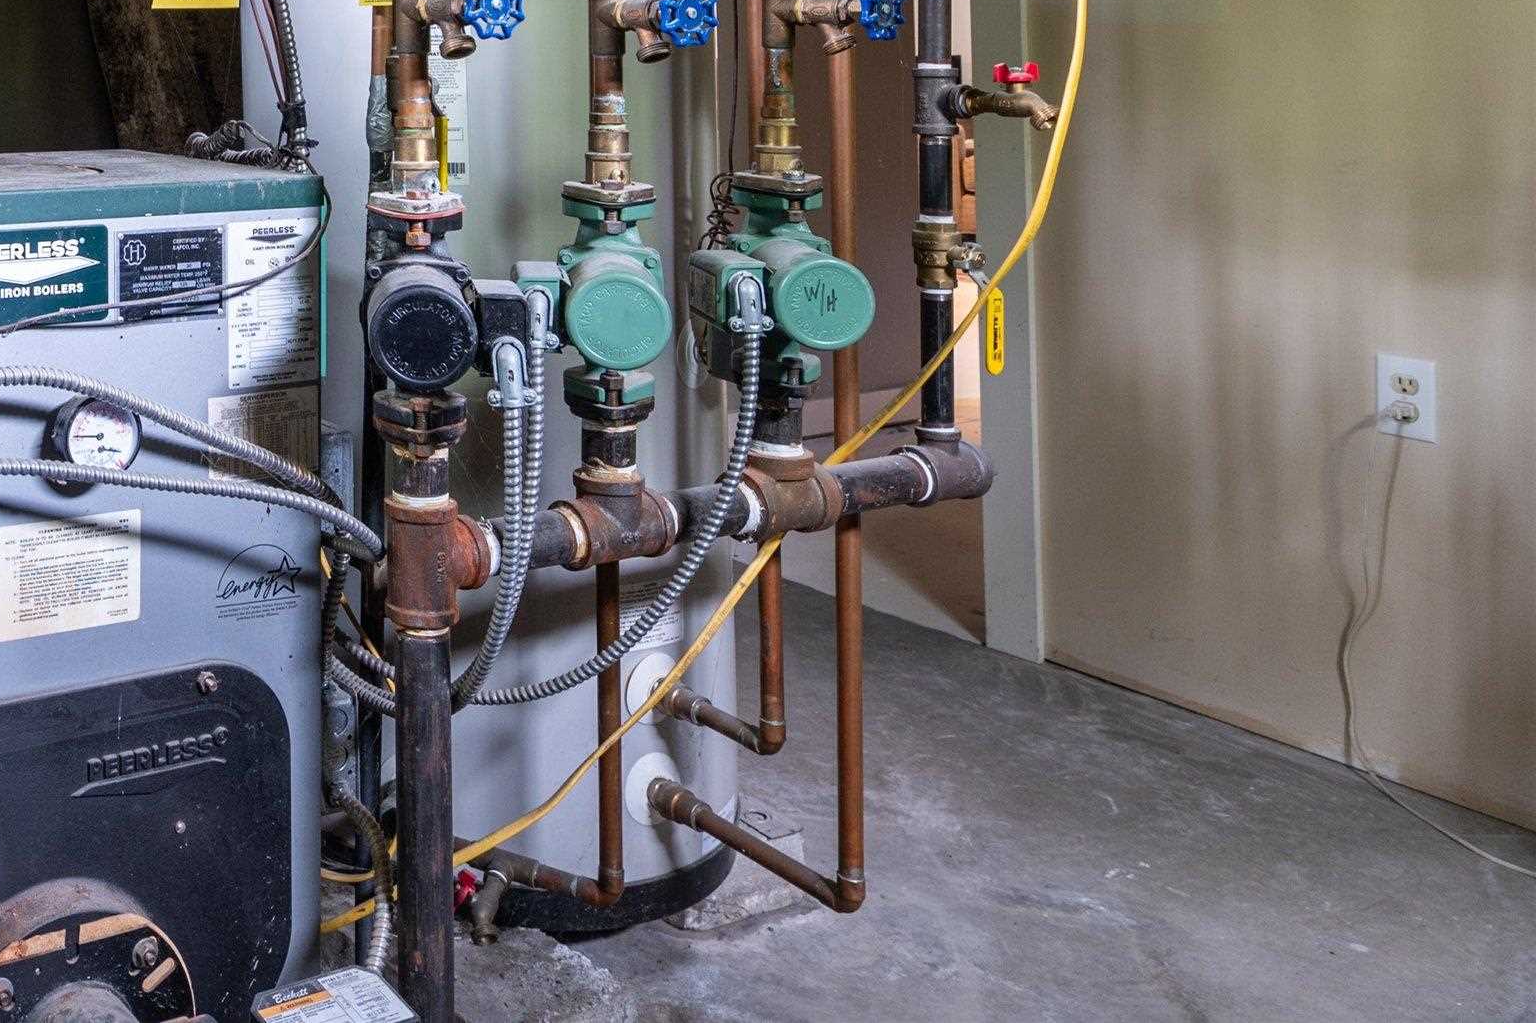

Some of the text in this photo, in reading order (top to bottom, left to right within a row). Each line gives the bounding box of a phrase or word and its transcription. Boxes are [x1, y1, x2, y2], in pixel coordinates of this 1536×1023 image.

[252, 225, 296, 235] PEERLESS
[129, 244, 140, 262] H
[0, 285, 31, 299] IRON
[33, 282, 84, 297] BOILERS
[804, 279, 838, 317] W/H
[86, 733, 214, 783] PEERLESS
[272, 987, 308, 1004] Beckett
